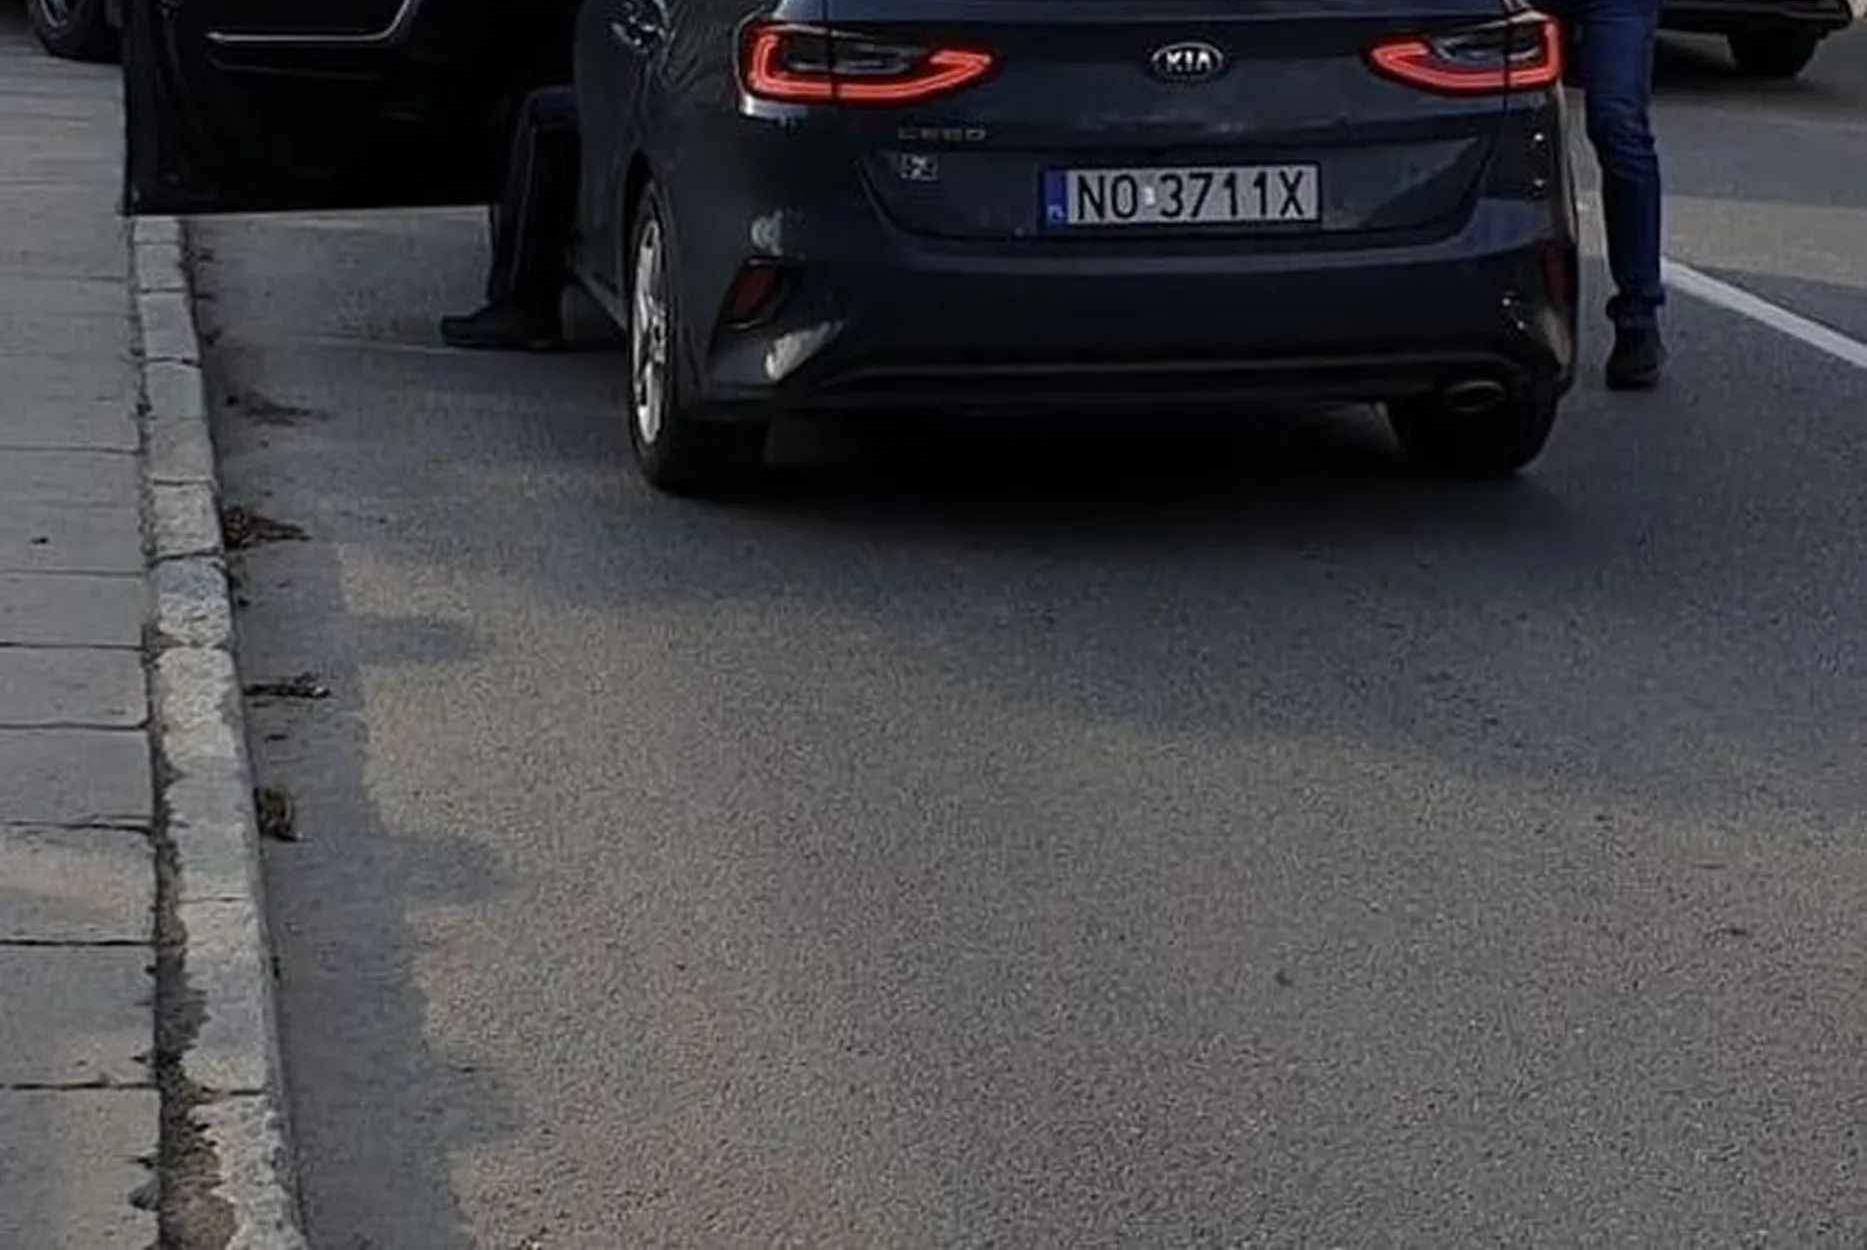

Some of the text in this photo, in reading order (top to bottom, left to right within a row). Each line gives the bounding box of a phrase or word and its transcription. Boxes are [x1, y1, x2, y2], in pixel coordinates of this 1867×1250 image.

[1166, 50, 1211, 72] KIA
[1077, 170, 1304, 220] NO 3711X
